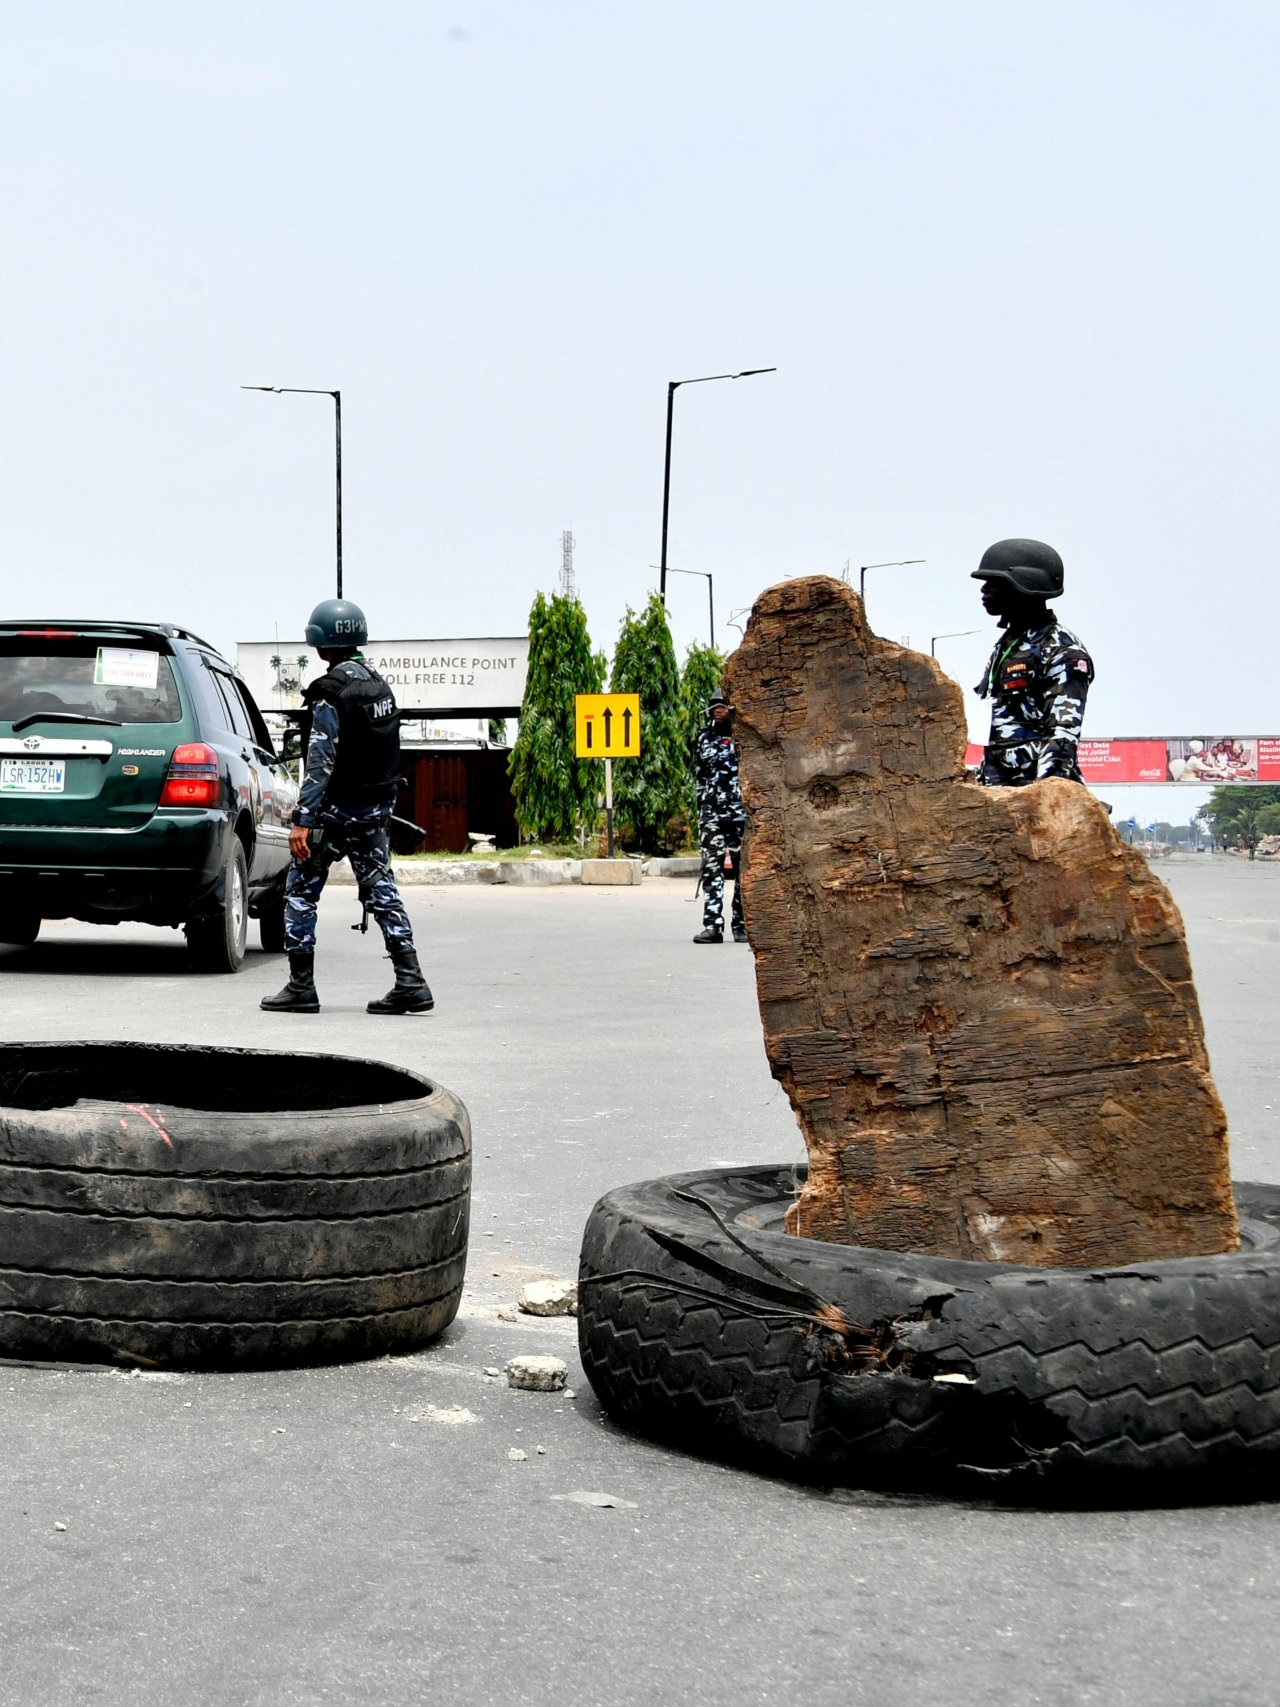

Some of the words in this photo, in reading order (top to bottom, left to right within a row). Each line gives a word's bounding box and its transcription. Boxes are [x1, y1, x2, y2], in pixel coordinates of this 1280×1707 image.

[378, 657, 467, 669] AMBULANCE
[472, 658, 517, 670] POINT
[380, 674, 410, 685] OLL
[415, 673, 446, 684] FREE
[451, 674, 475, 685] 112
[373, 698, 393, 718] NPF
[117, 748, 166, 756] HIGHLANDER
